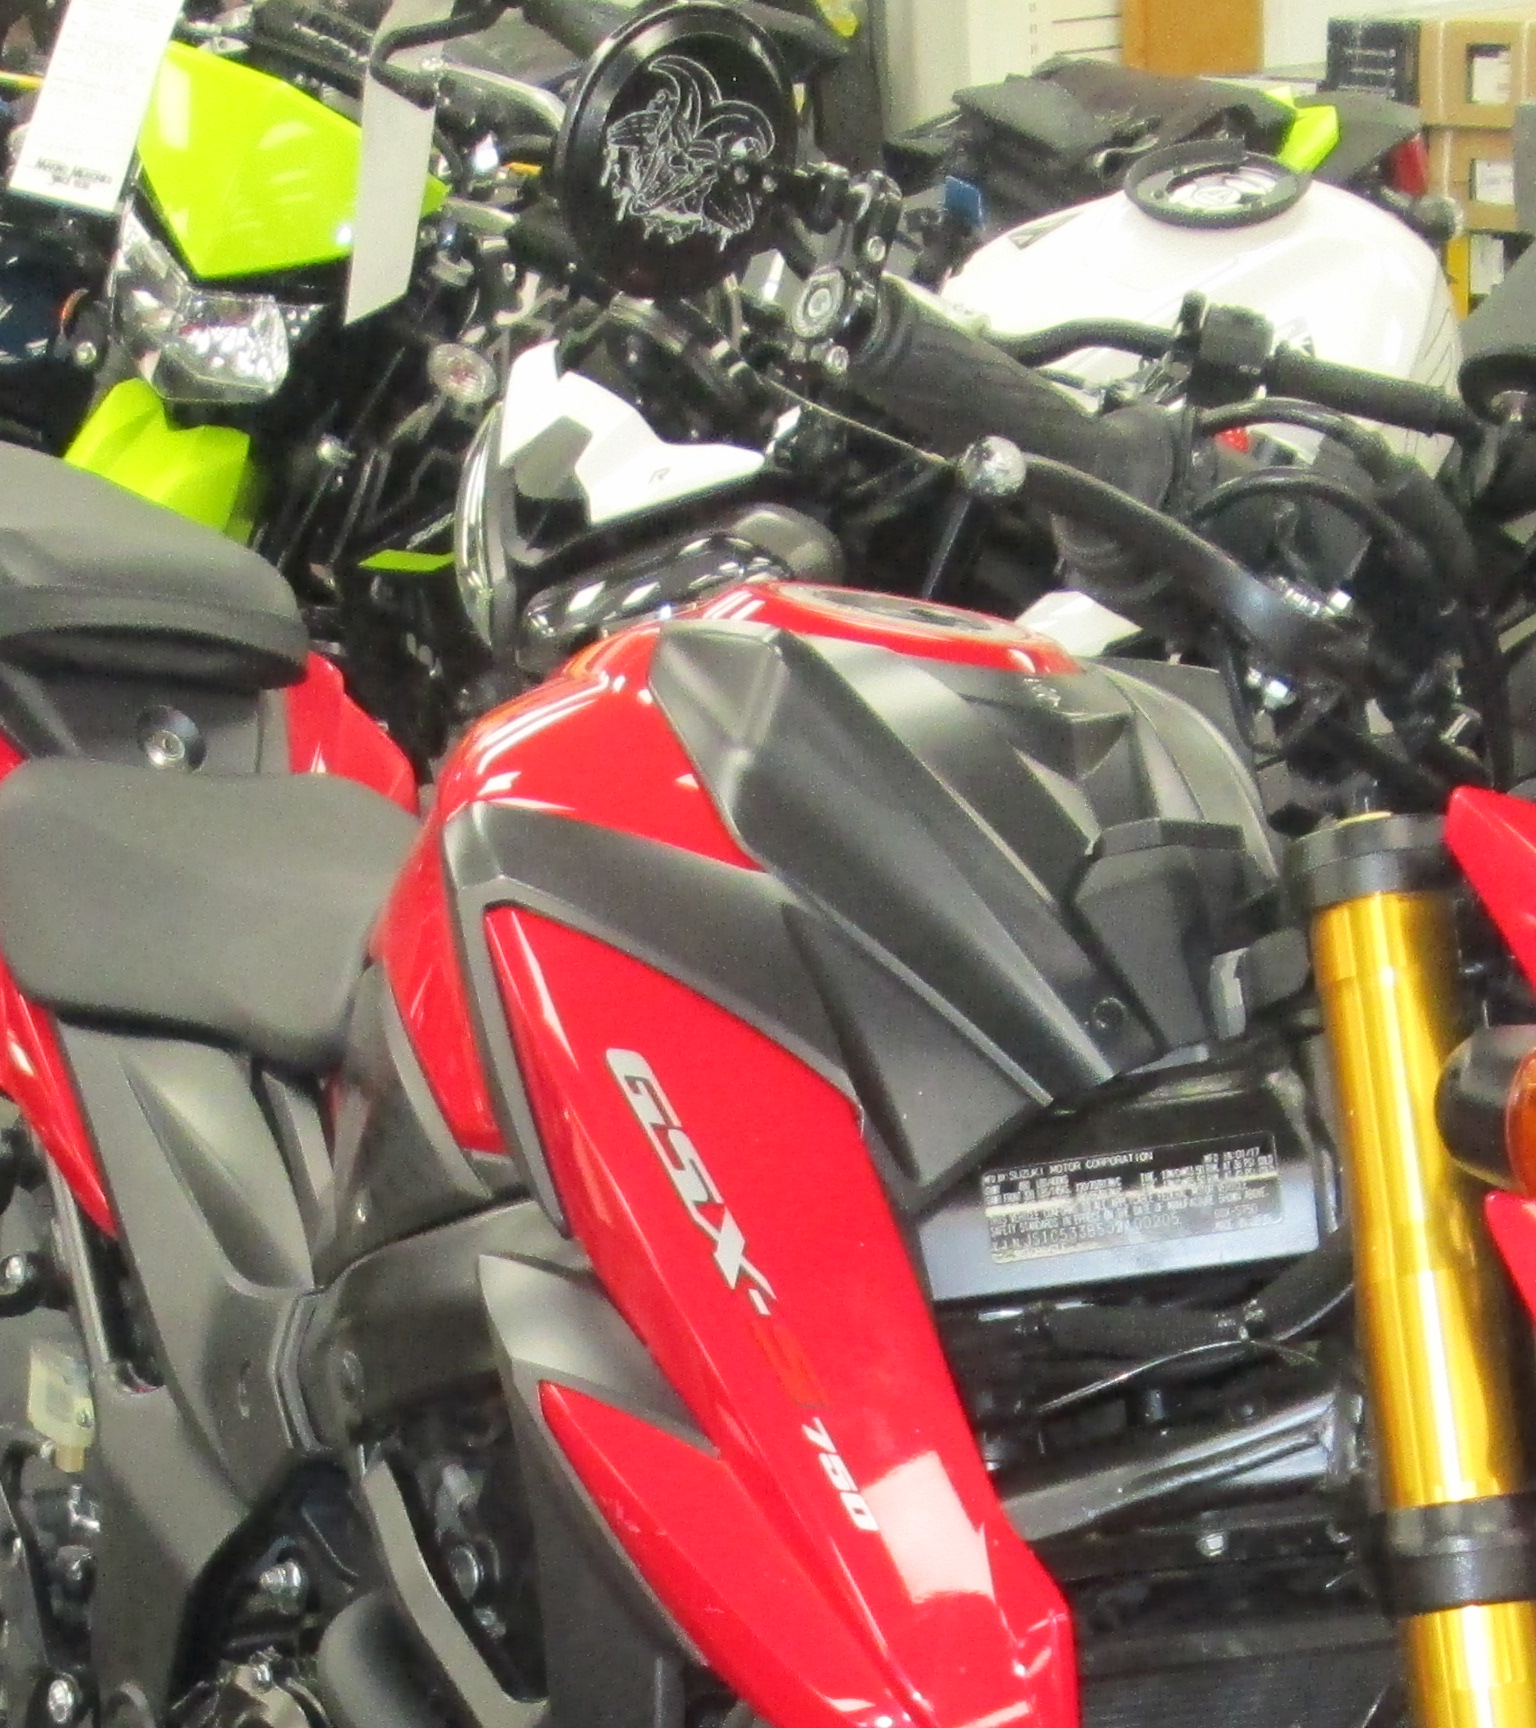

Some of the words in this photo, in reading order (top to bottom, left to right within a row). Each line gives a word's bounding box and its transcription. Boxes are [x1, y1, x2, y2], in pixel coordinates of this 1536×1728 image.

[1049, 1160, 1082, 1174] MOTOR
[1085, 1151, 1154, 1169] CORPORATION
[802, 1417, 879, 1532] 750
